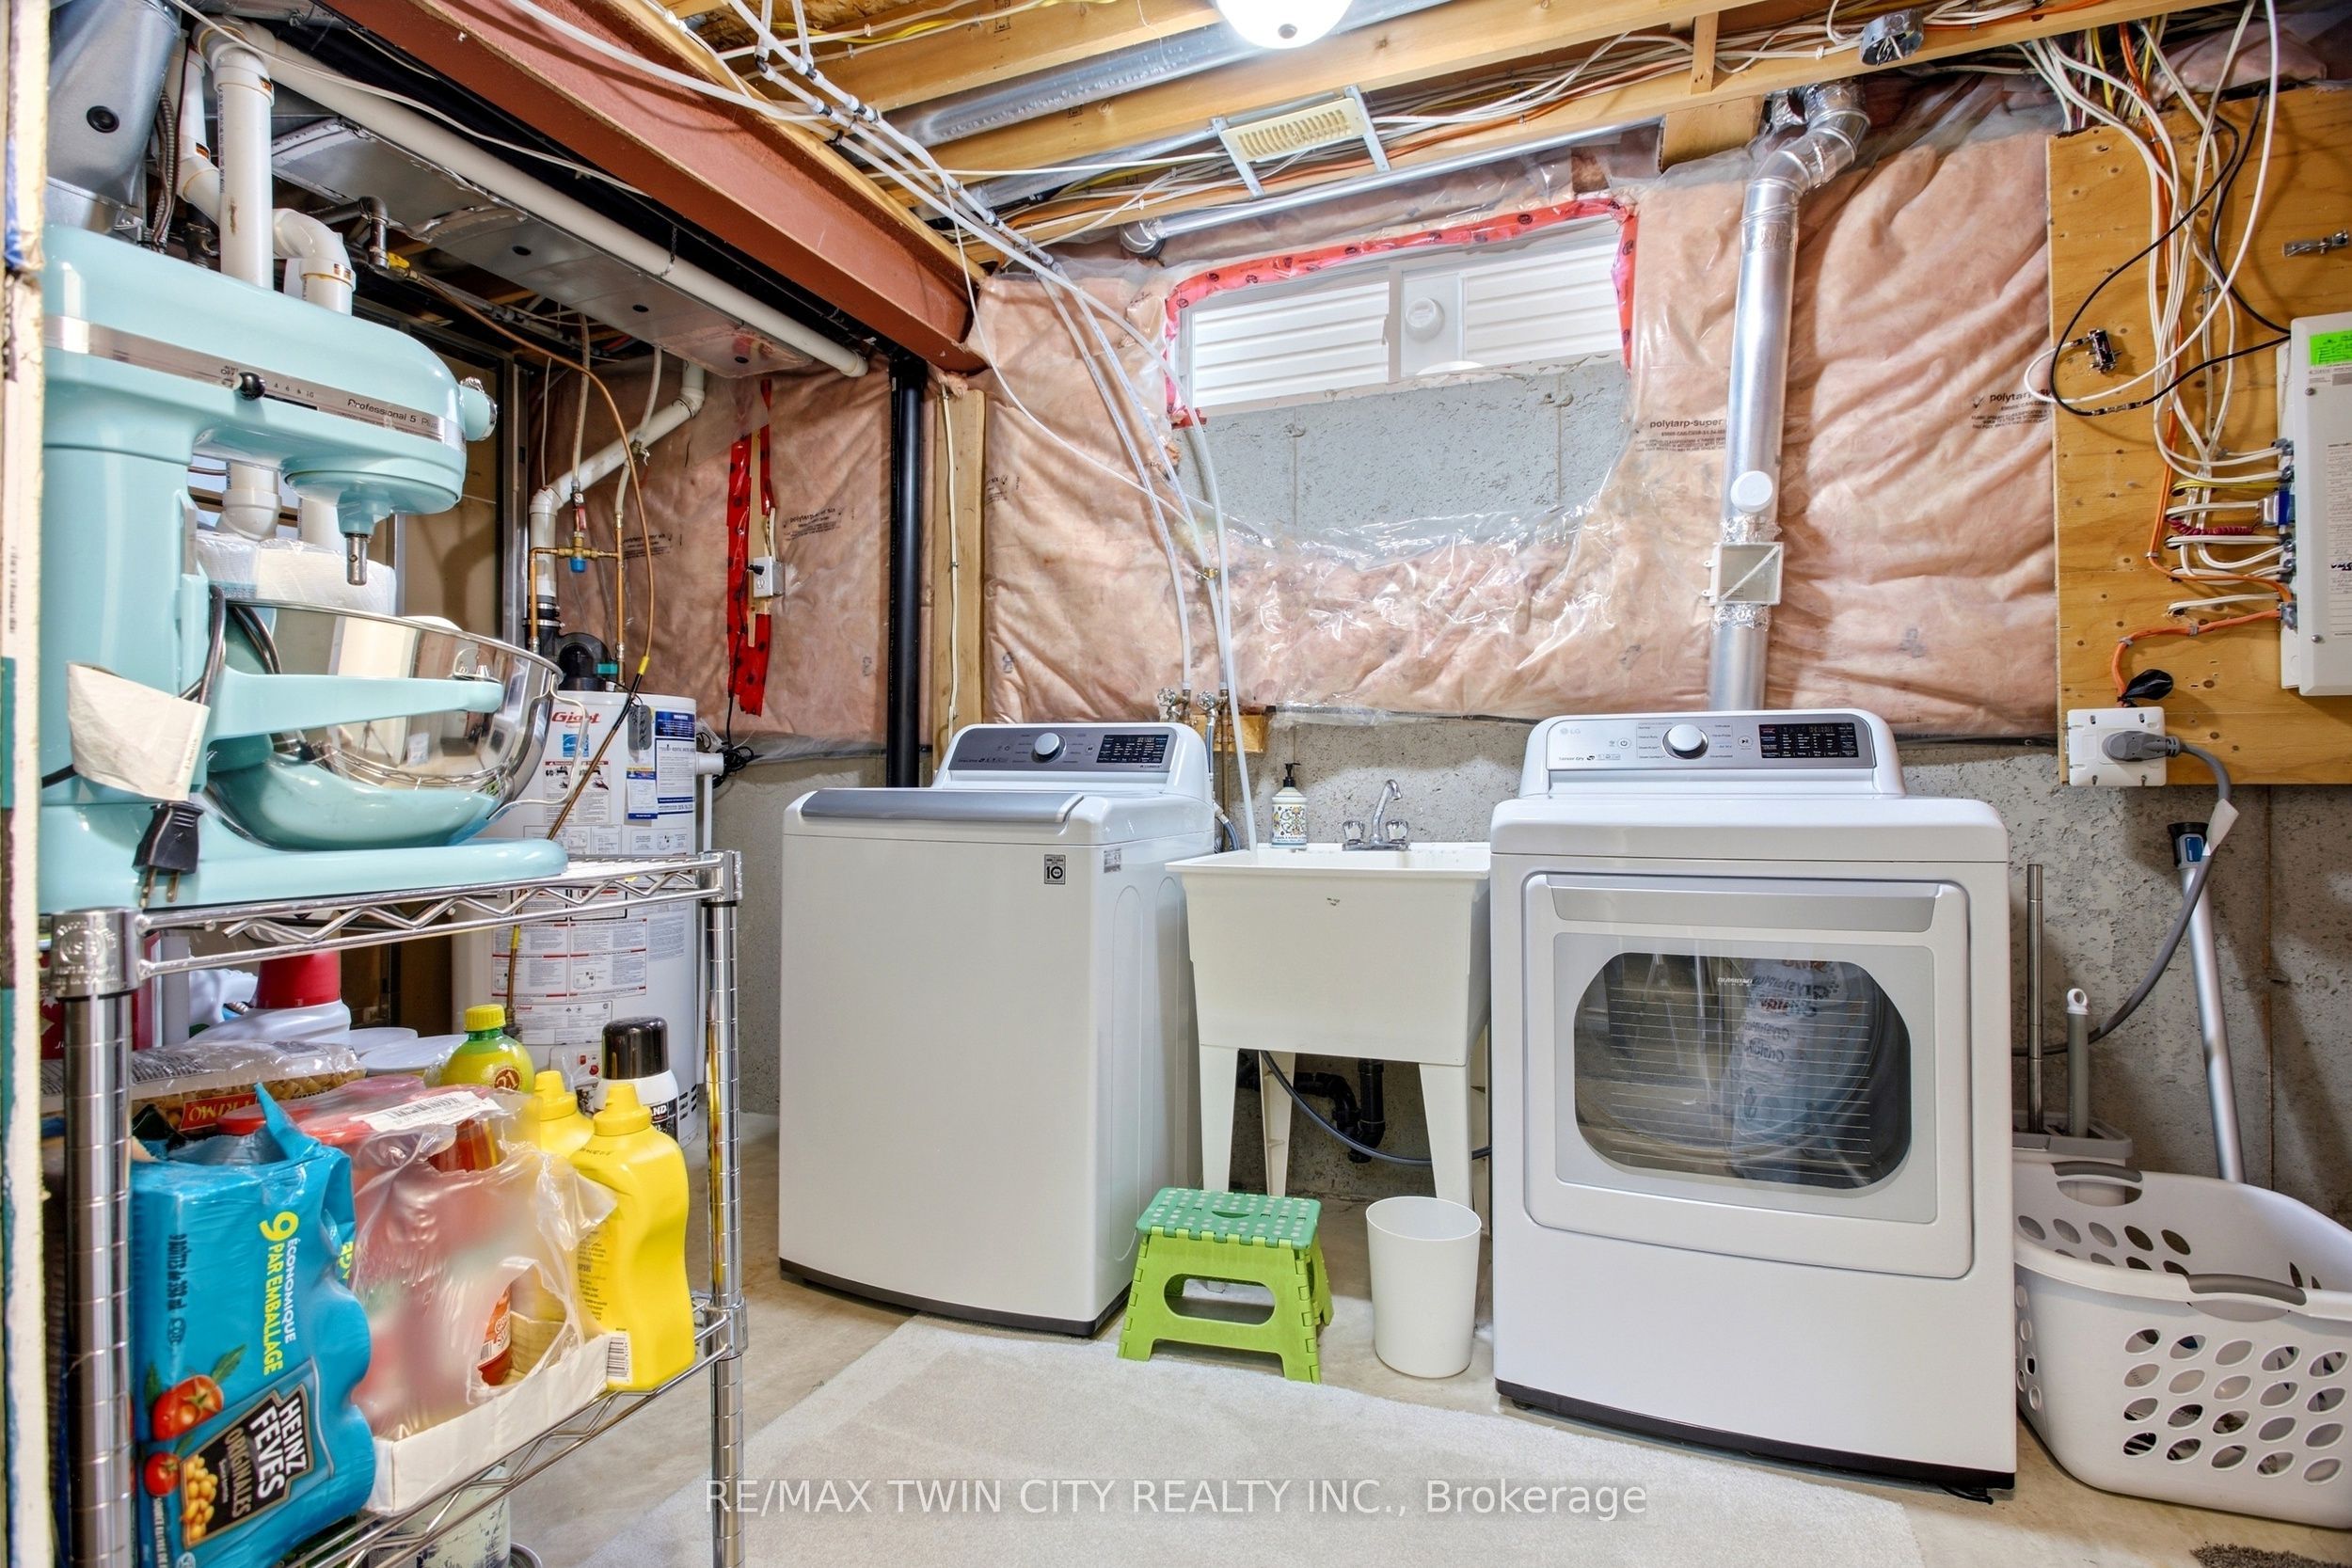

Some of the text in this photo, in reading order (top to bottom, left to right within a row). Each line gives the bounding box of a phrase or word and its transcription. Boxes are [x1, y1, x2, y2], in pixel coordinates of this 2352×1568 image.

[347, 398, 406, 420] Professional
[410, 415, 417, 423] 5
[551, 711, 600, 724] Giat
[258, 1211, 299, 1376] 9 PAR EMBALLAGE
[283, 1238, 301, 1343] ÉCONOMIQUE
[224, 1426, 253, 1519] ORIGINALES
[279, 1398, 308, 1476] HEINZ
